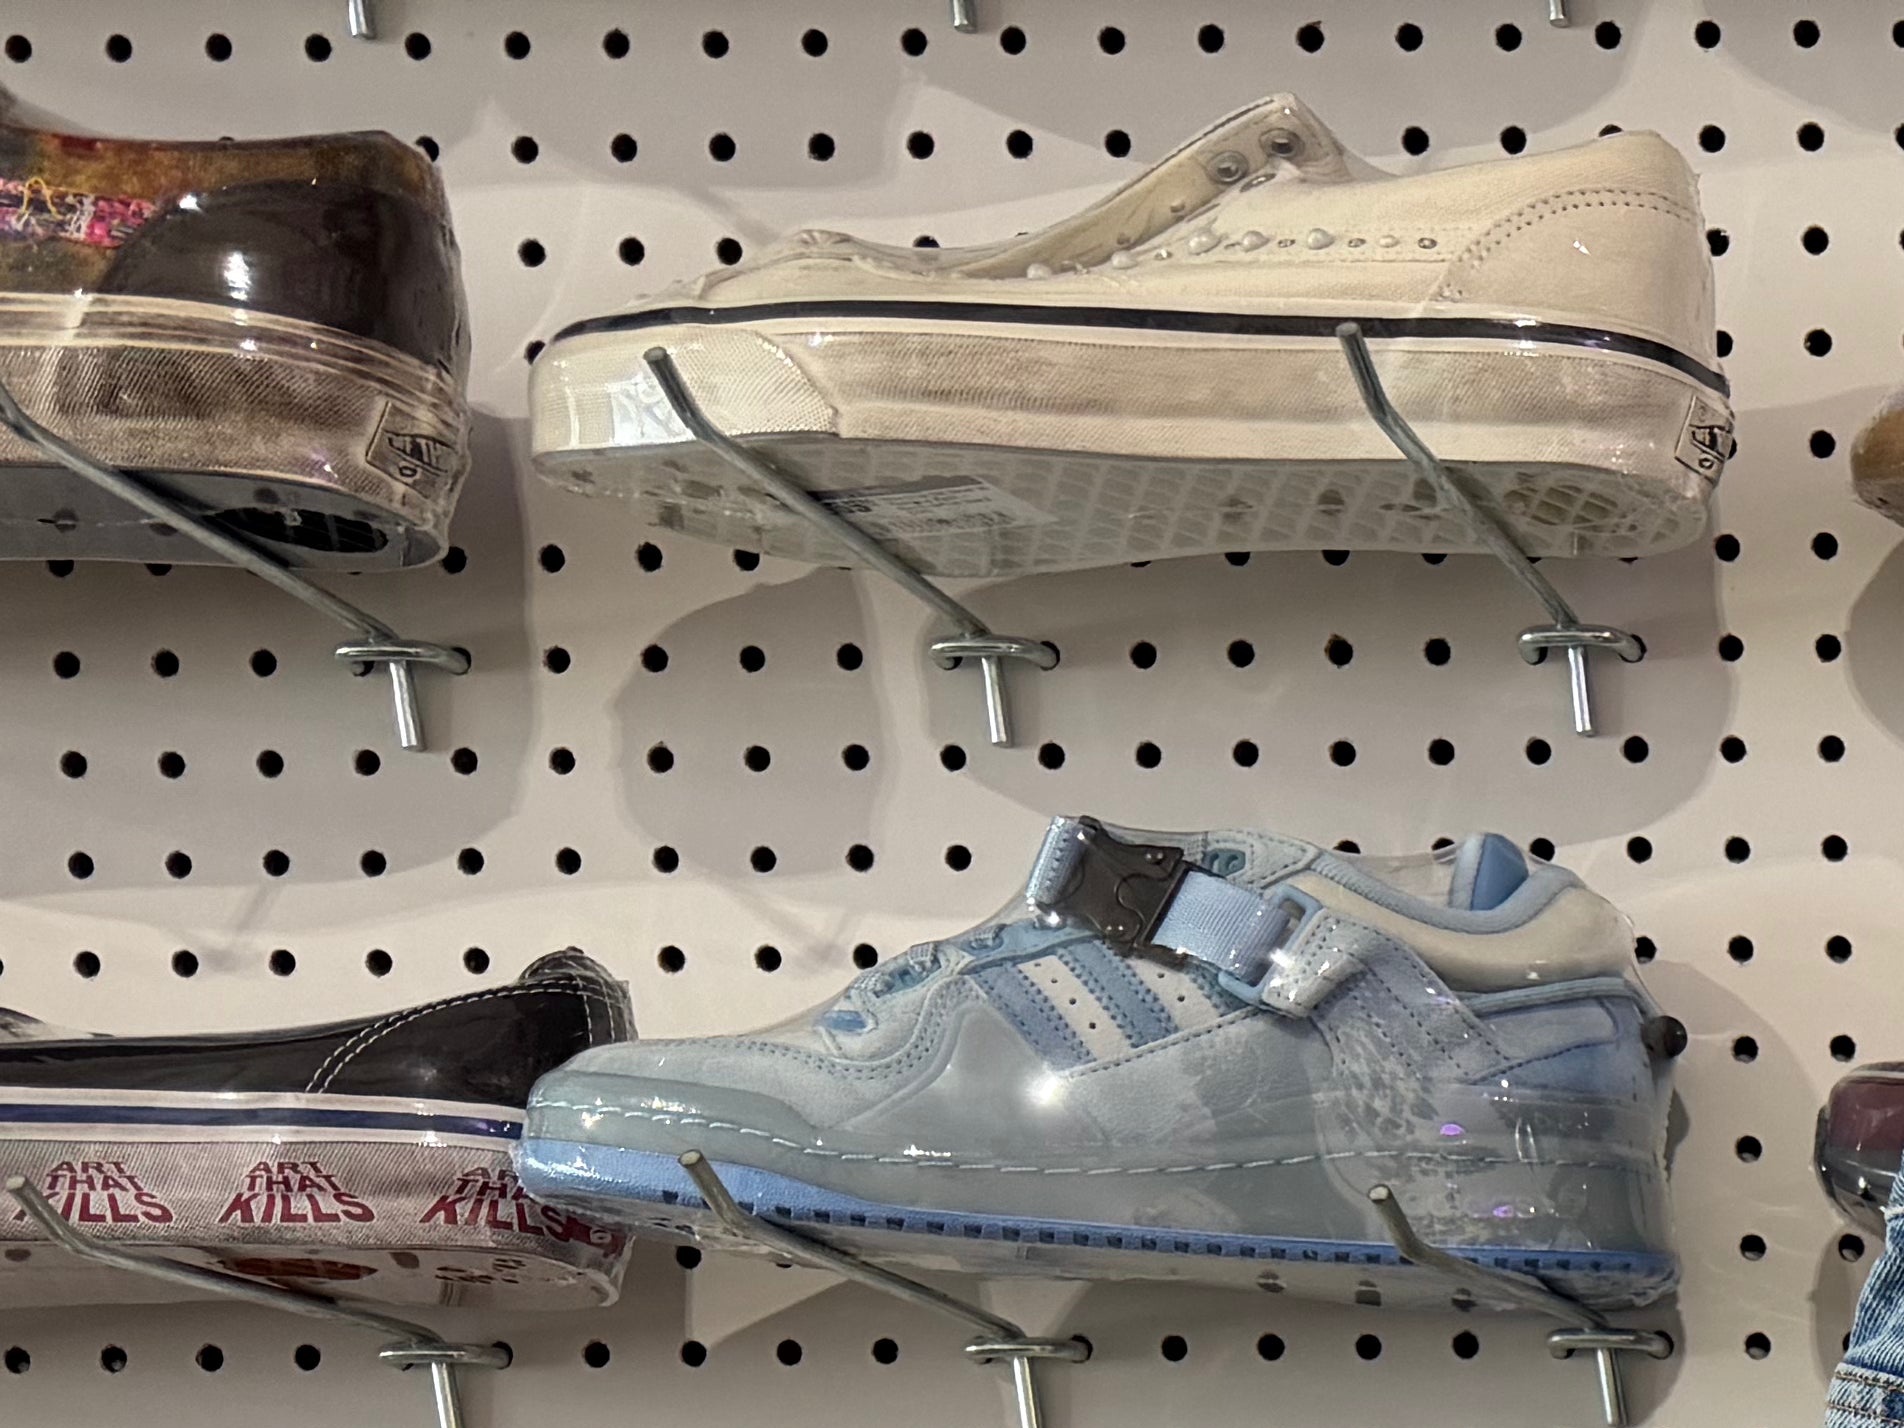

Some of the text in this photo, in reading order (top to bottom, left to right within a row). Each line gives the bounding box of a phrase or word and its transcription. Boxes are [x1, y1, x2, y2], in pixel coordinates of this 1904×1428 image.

[50, 1161, 127, 1175] ART
[248, 1161, 327, 1175] ART
[462, 1167, 519, 1182] AR
[46, 1174, 145, 1192] THAT
[244, 1174, 345, 1193] THAT
[217, 1192, 375, 1224] KILLS
[419, 1194, 573, 1243] KILLS
